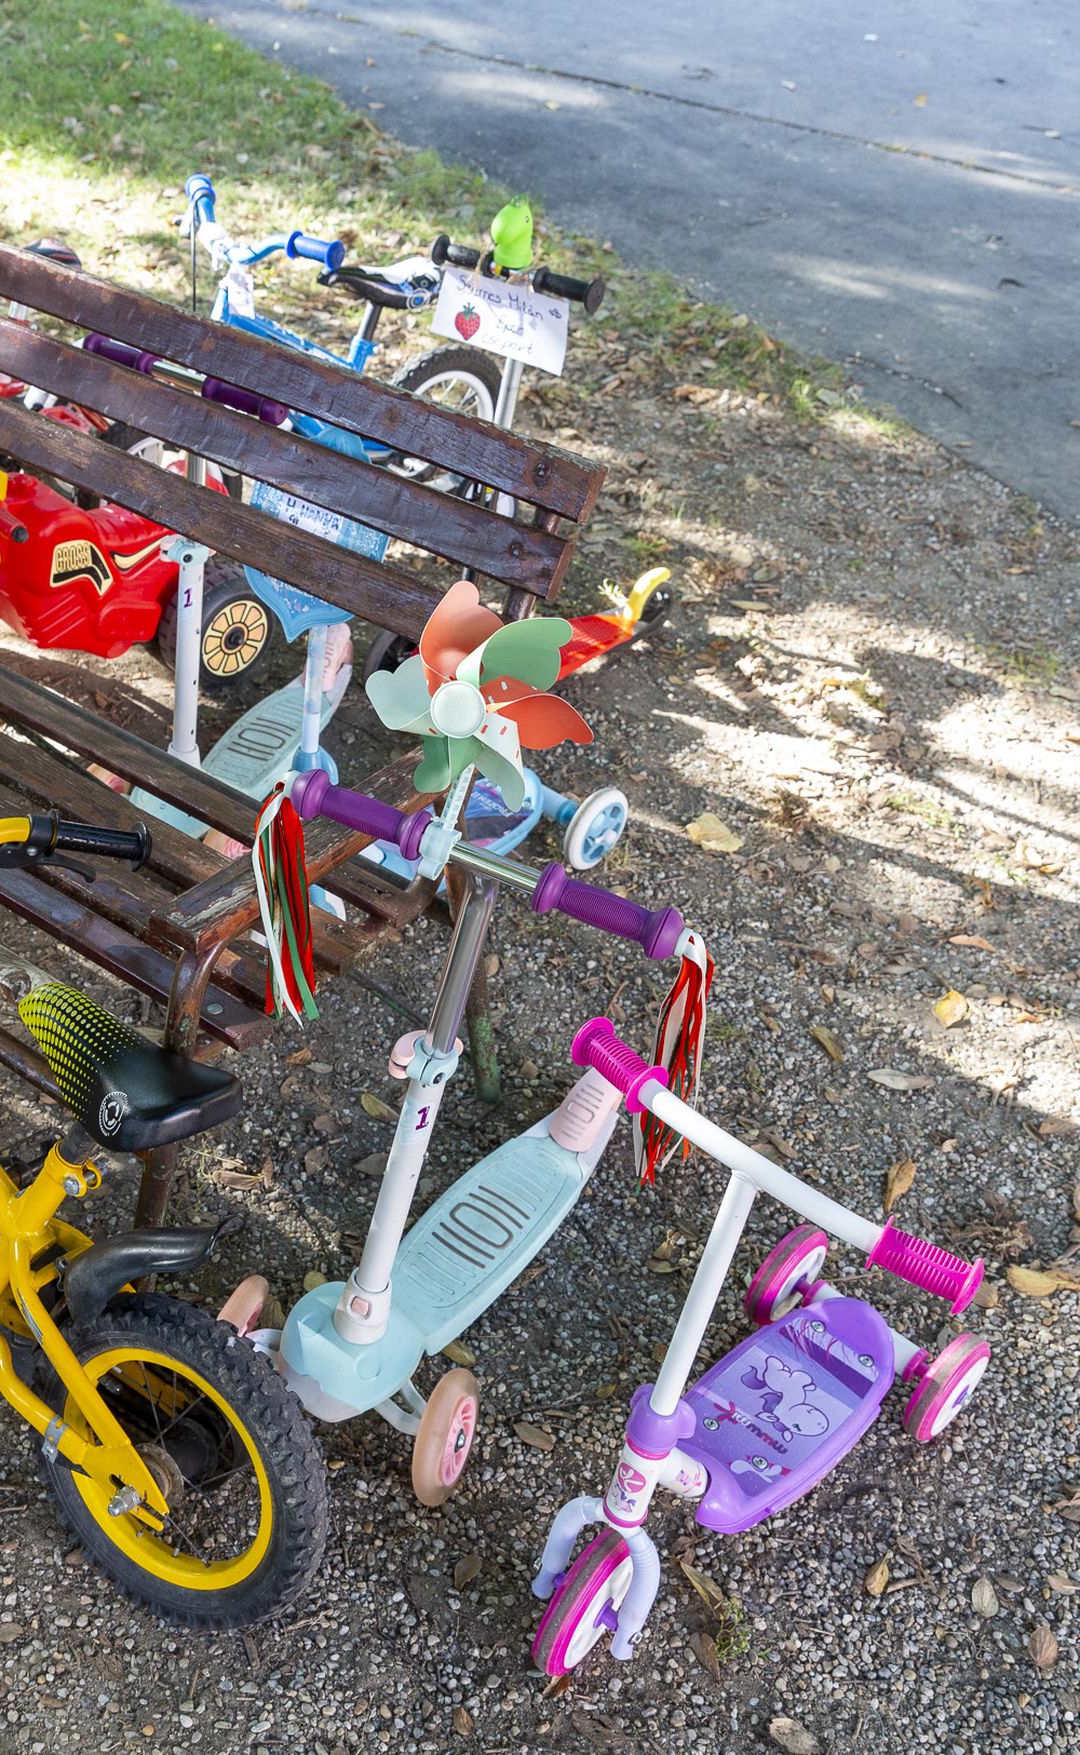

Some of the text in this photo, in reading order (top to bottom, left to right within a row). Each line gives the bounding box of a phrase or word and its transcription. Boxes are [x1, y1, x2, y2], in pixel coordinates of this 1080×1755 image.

[54, 543, 91, 574] CROSS
[183, 588, 193, 609] 1
[415, 1105, 431, 1131] 1
